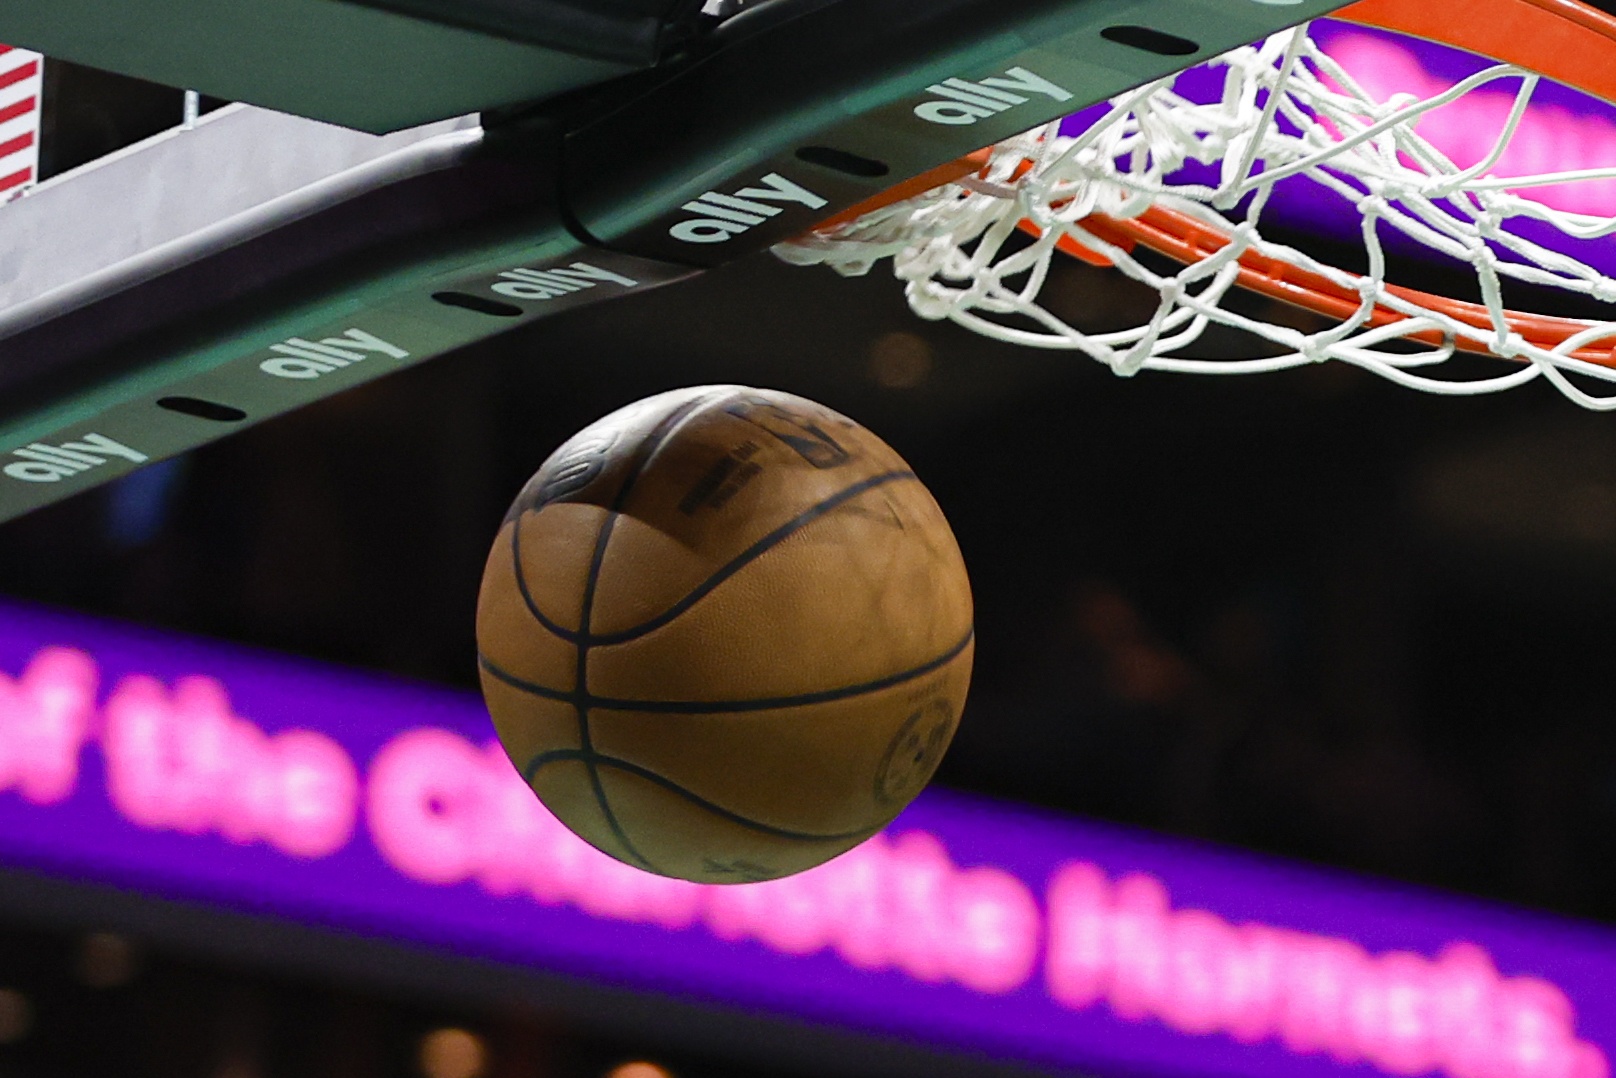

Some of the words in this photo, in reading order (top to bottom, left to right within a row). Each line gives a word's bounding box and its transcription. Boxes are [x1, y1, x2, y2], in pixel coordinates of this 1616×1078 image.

[914, 66, 1074, 126] ally
[669, 172, 828, 245] ally
[490, 260, 638, 301] ally
[259, 328, 410, 381] ally
[3, 432, 149, 483] ally
[103, 673, 360, 858] the
